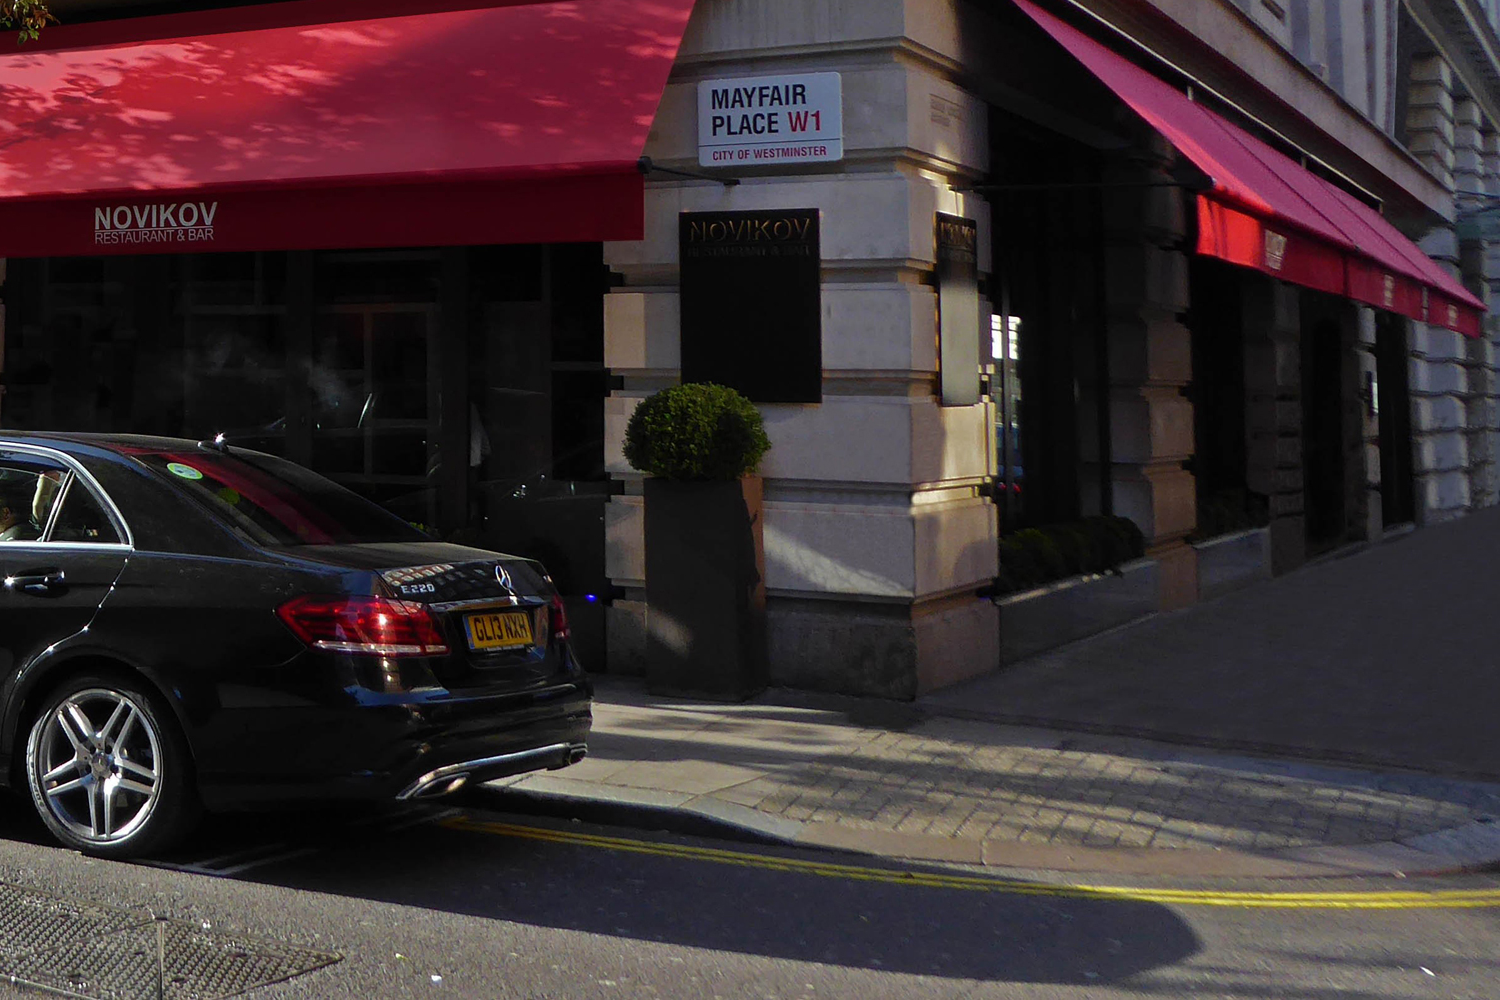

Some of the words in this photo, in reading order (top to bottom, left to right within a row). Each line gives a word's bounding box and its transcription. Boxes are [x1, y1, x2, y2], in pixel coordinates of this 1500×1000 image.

[711, 84, 807, 109] MAYFAIR
[712, 112, 779, 136] PLACE
[787, 110, 821, 132] W1
[712, 150, 734, 161] CITY
[737, 149, 750, 159] OF
[753, 146, 827, 159] WESTMINSTER
[95, 202, 218, 230] NOVIKOV
[95, 230, 175, 244] RESTAURANT
[176, 229, 185, 241] &
[188, 228, 214, 241] BAR
[689, 217, 811, 242] NOVIKOV
[474, 616, 503, 641] GL13
